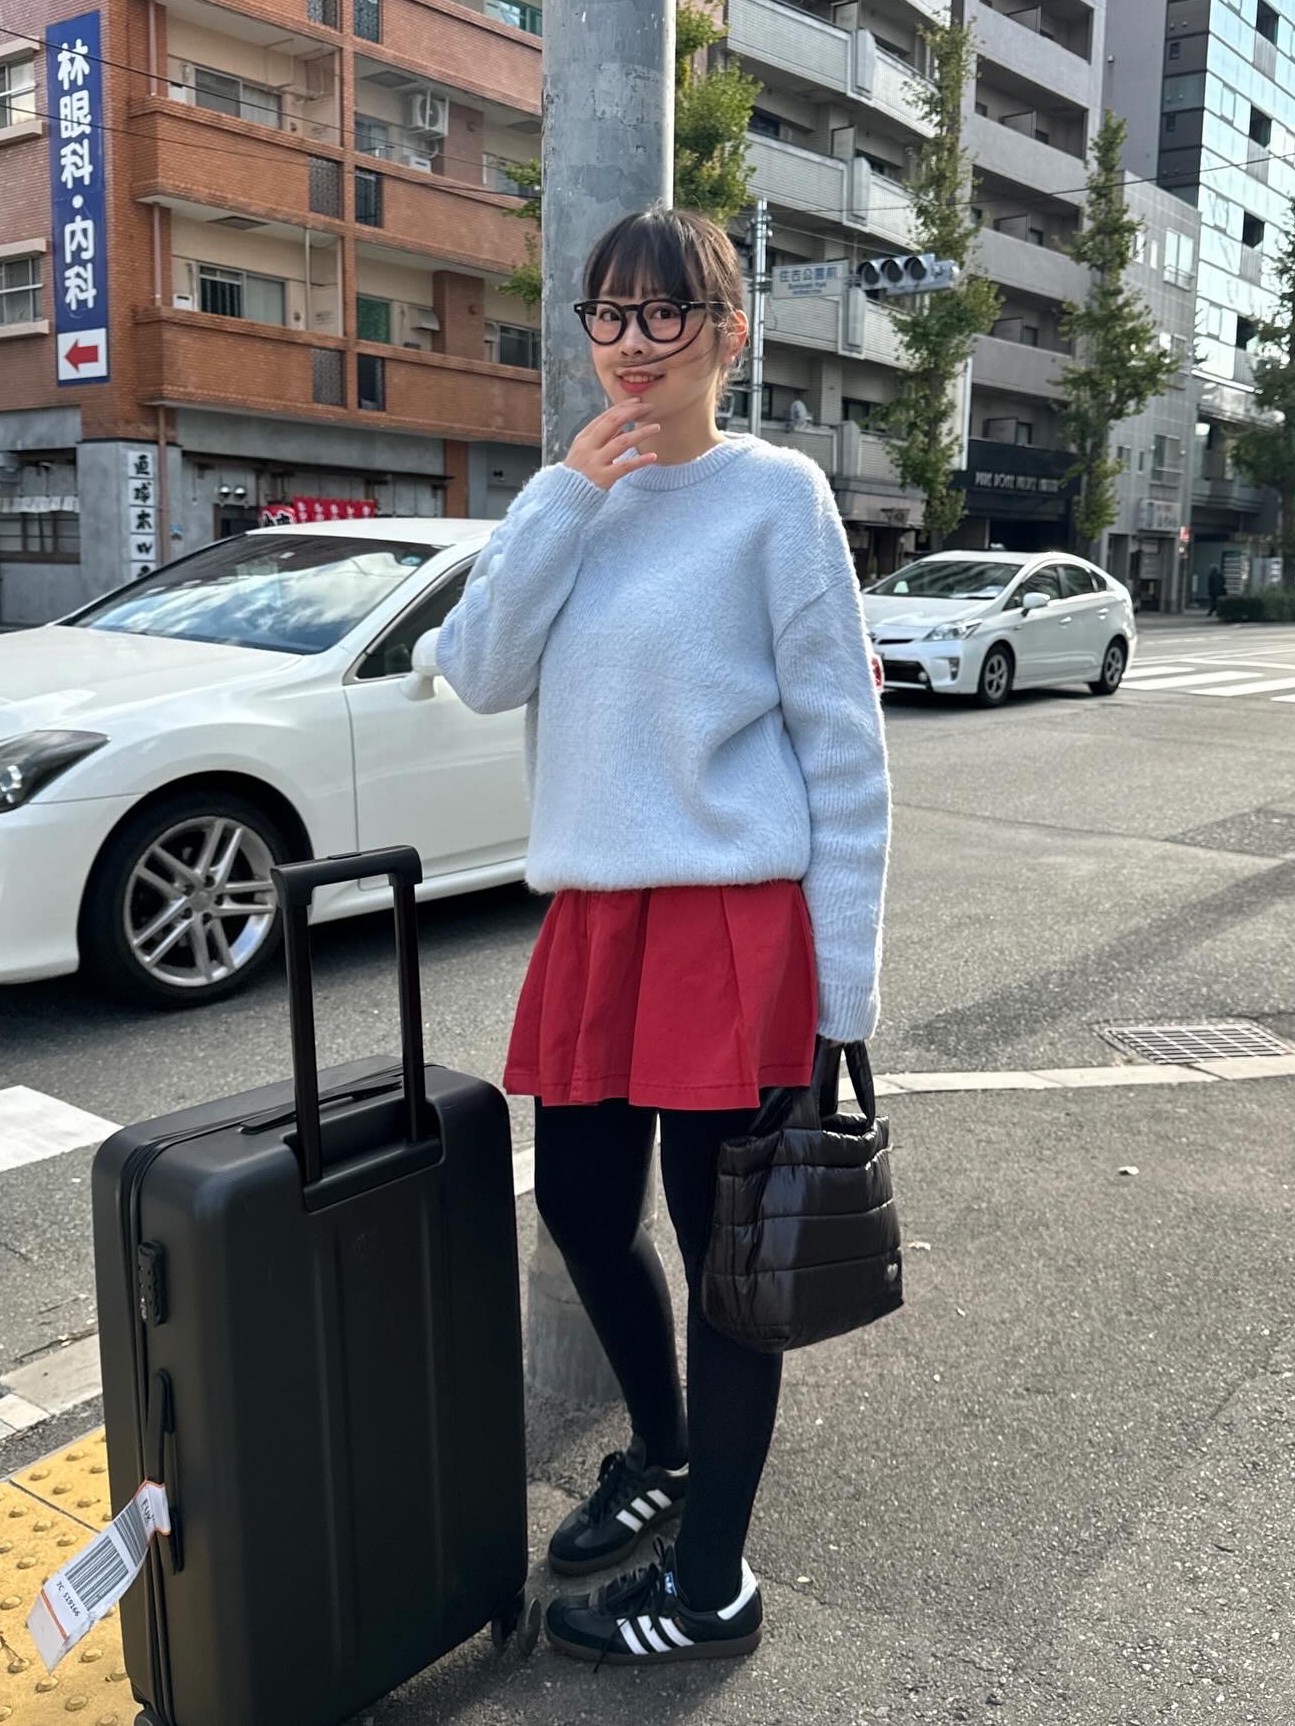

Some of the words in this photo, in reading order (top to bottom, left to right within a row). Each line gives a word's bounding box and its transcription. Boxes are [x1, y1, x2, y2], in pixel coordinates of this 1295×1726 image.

[57, 38, 97, 311] 林眼科・内科
